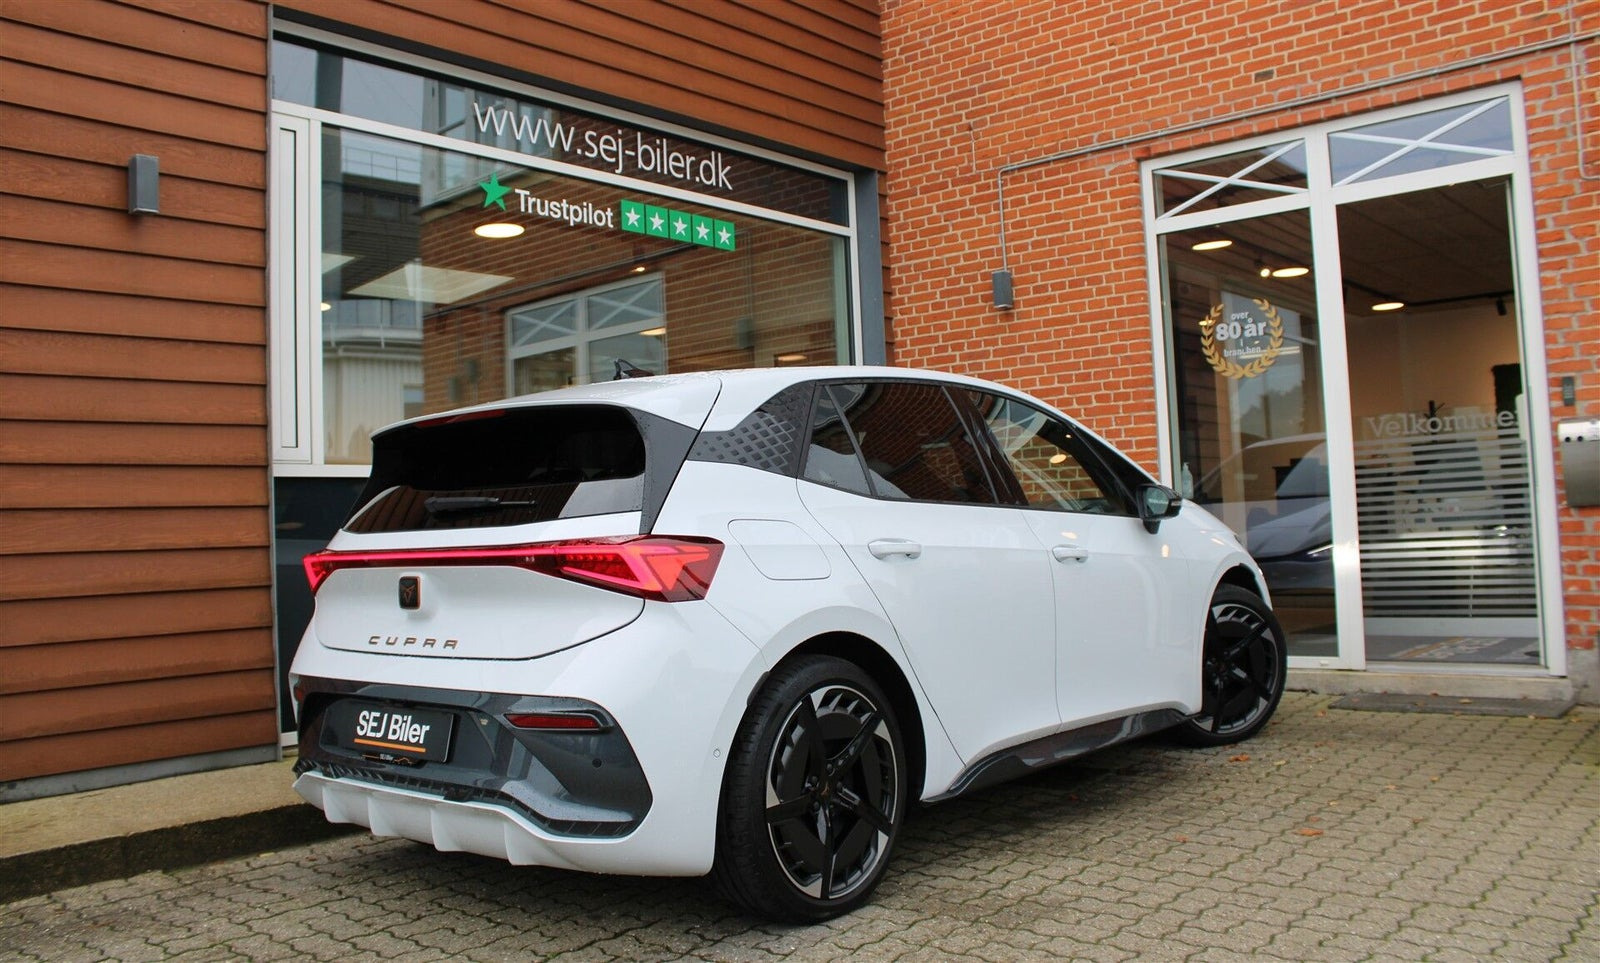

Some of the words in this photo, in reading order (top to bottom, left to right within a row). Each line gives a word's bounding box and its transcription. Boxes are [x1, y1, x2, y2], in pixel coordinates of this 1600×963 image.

[474, 102, 733, 190] www.sej-biler.dk
[515, 188, 614, 228] Trustpilot
[1216, 321, 1241, 341] 80
[1244, 317, 1267, 337] år
[1231, 311, 1249, 320] over
[368, 635, 459, 650] CUPRA
[356, 710, 388, 738] SEJ
[388, 713, 430, 744] Biler
